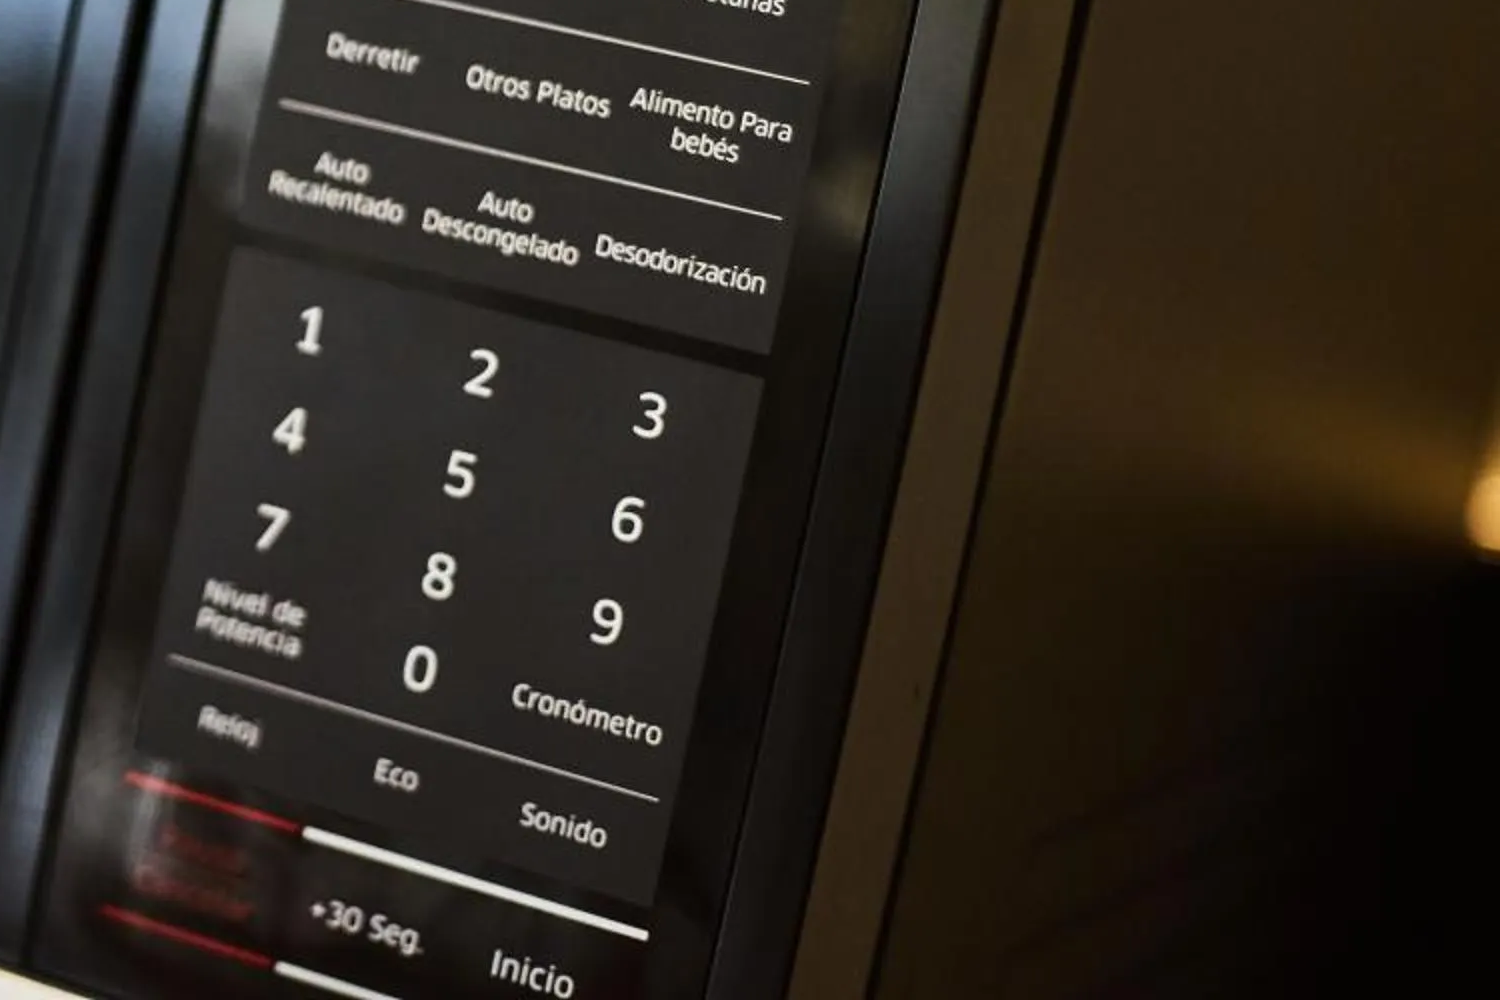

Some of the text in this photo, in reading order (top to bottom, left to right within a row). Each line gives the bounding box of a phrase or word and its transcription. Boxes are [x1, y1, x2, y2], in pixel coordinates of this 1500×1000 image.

[325, 31, 420, 76] Derretir
[465, 63, 612, 118] Otros Platos
[629, 86, 794, 144] Alimento Para
[313, 150, 372, 186] Auto
[670, 126, 740, 165] bebés
[266, 169, 406, 226] Recalentado
[477, 190, 535, 225] Auto
[421, 207, 580, 267] Descongelado
[595, 233, 768, 295] Desodorización
[296, 305, 324, 355] 1
[463, 348, 499, 399] 2
[271, 407, 308, 454] 4
[632, 391, 668, 440] 3
[443, 449, 478, 499] 5
[254, 502, 291, 552] 7
[610, 496, 646, 543] 6
[421, 551, 457, 601] 8
[271, 598, 307, 628] de
[589, 598, 624, 646] 9
[402, 645, 438, 693] 0
[510, 682, 664, 747] Cronómetro
[374, 757, 420, 793] Eco
[519, 801, 608, 850] Sonido
[309, 900, 363, 936] +30
[490, 948, 575, 1000] Inicio
